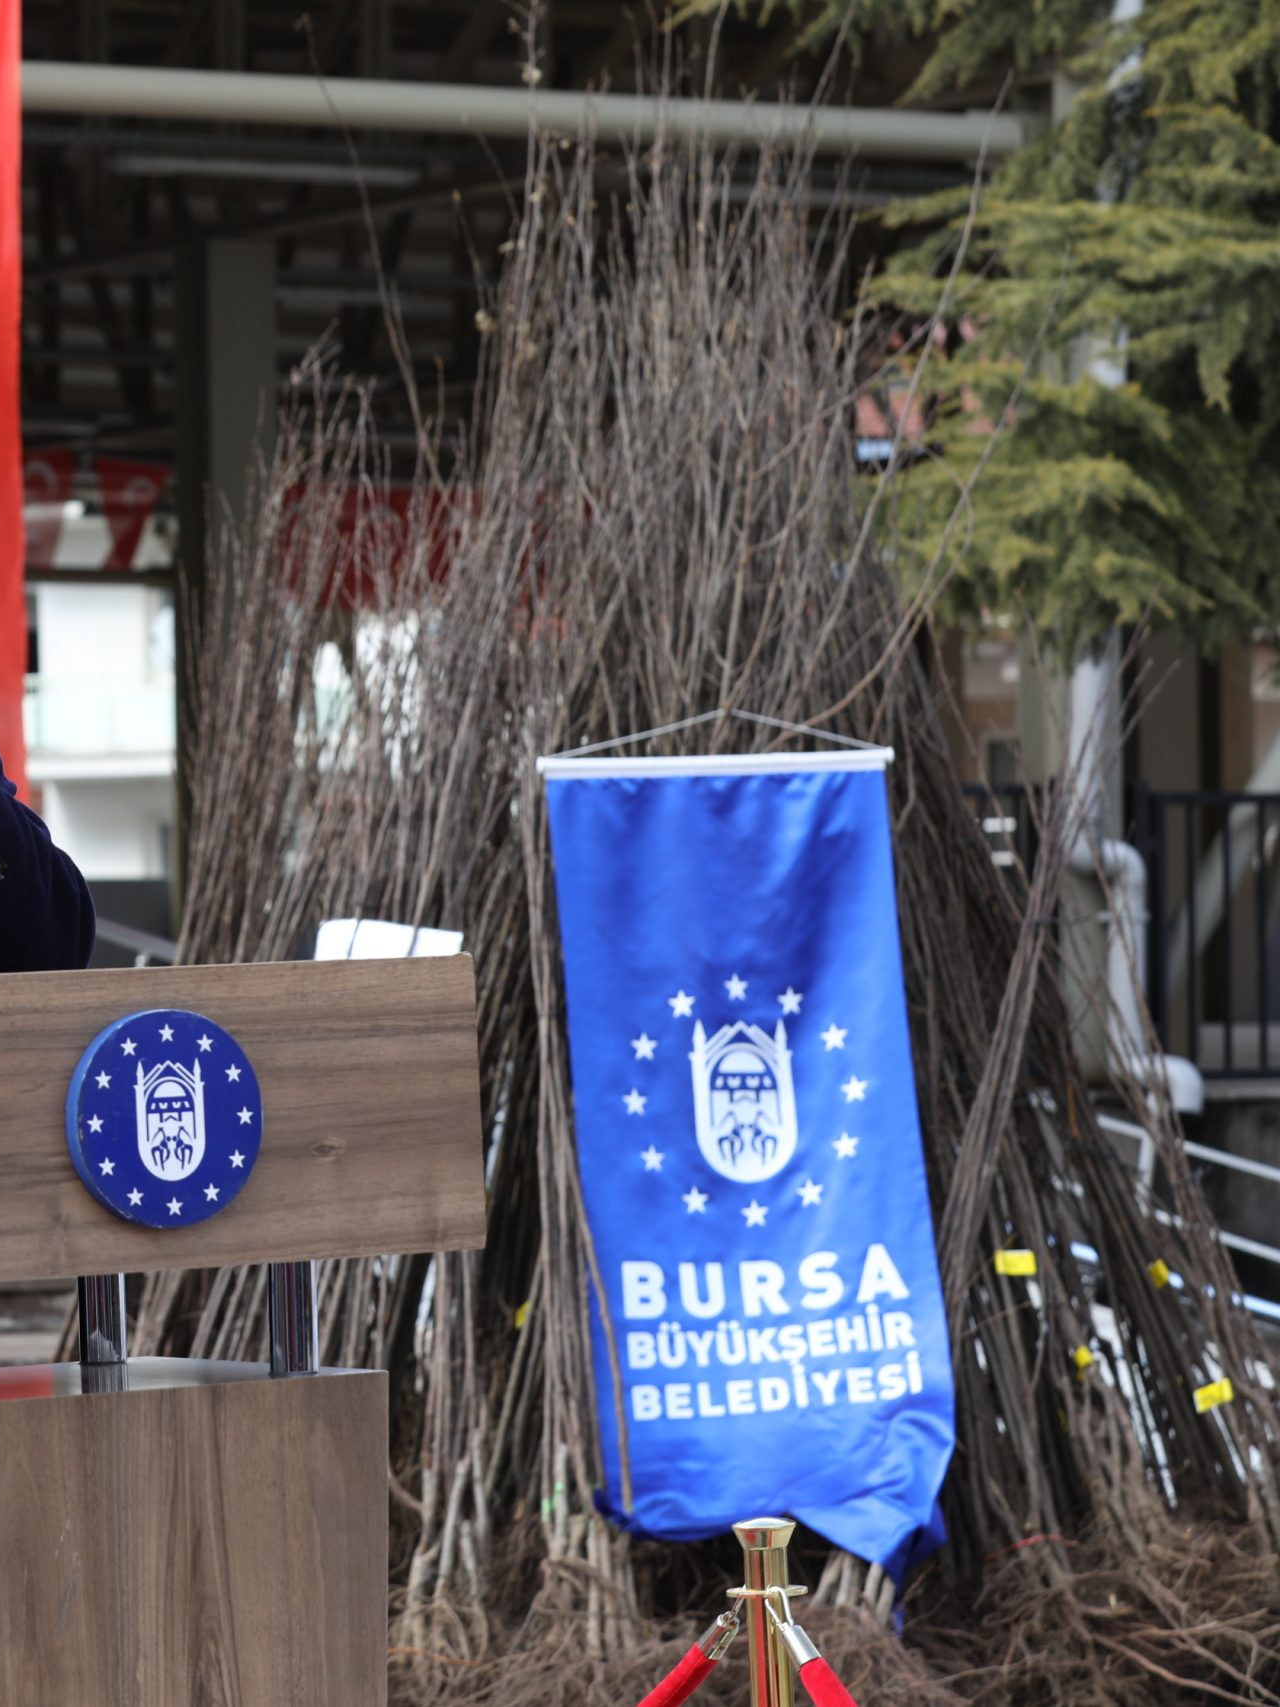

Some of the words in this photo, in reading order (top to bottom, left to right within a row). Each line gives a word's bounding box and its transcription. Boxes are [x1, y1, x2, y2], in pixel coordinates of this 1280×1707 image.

[621, 1243, 911, 1320] BURSA
[626, 1302, 917, 1370] BÜYÜKŞEHİR
[631, 1350, 924, 1422] BELEDİYESİ
